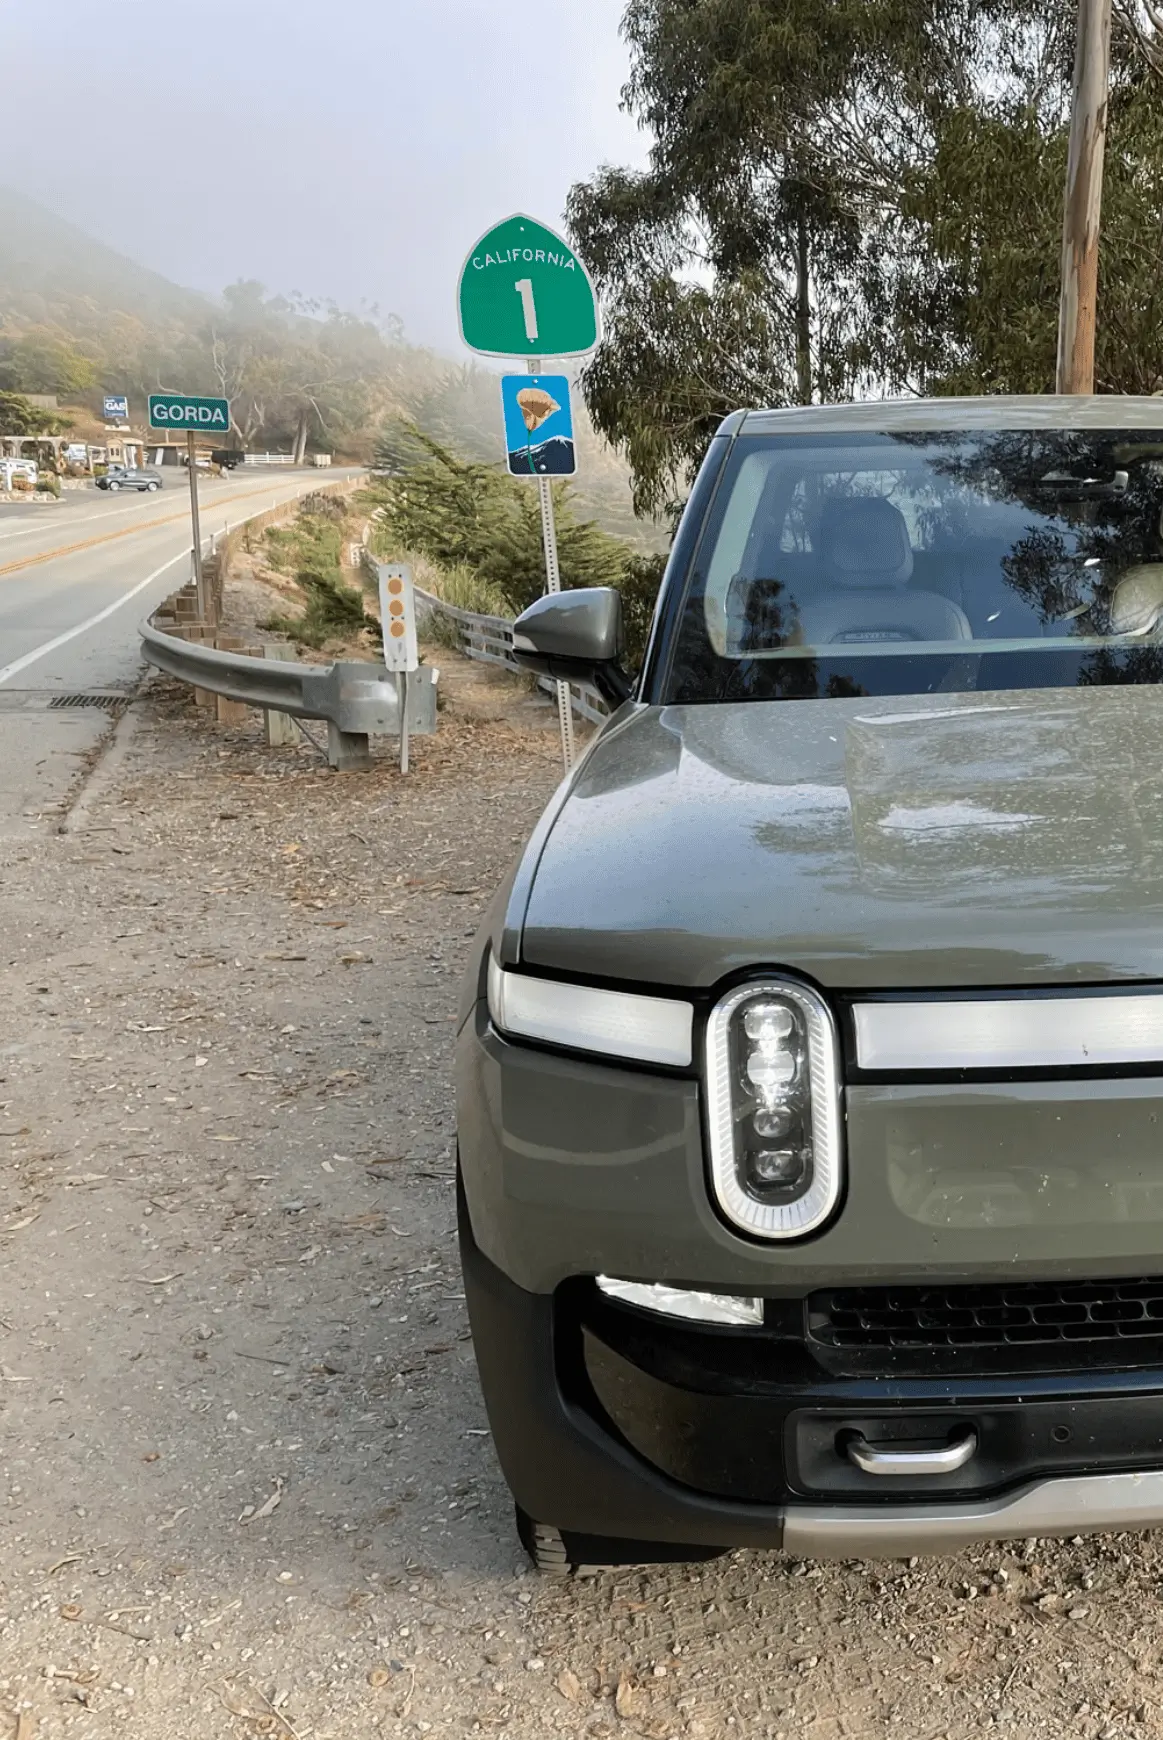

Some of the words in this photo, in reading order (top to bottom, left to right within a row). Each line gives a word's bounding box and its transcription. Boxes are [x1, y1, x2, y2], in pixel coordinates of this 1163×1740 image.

[472, 248, 576, 272] CALIFORNIA
[514, 278, 539, 339] 1
[105, 402, 125, 411] GAS
[153, 403, 225, 423] GORDA
